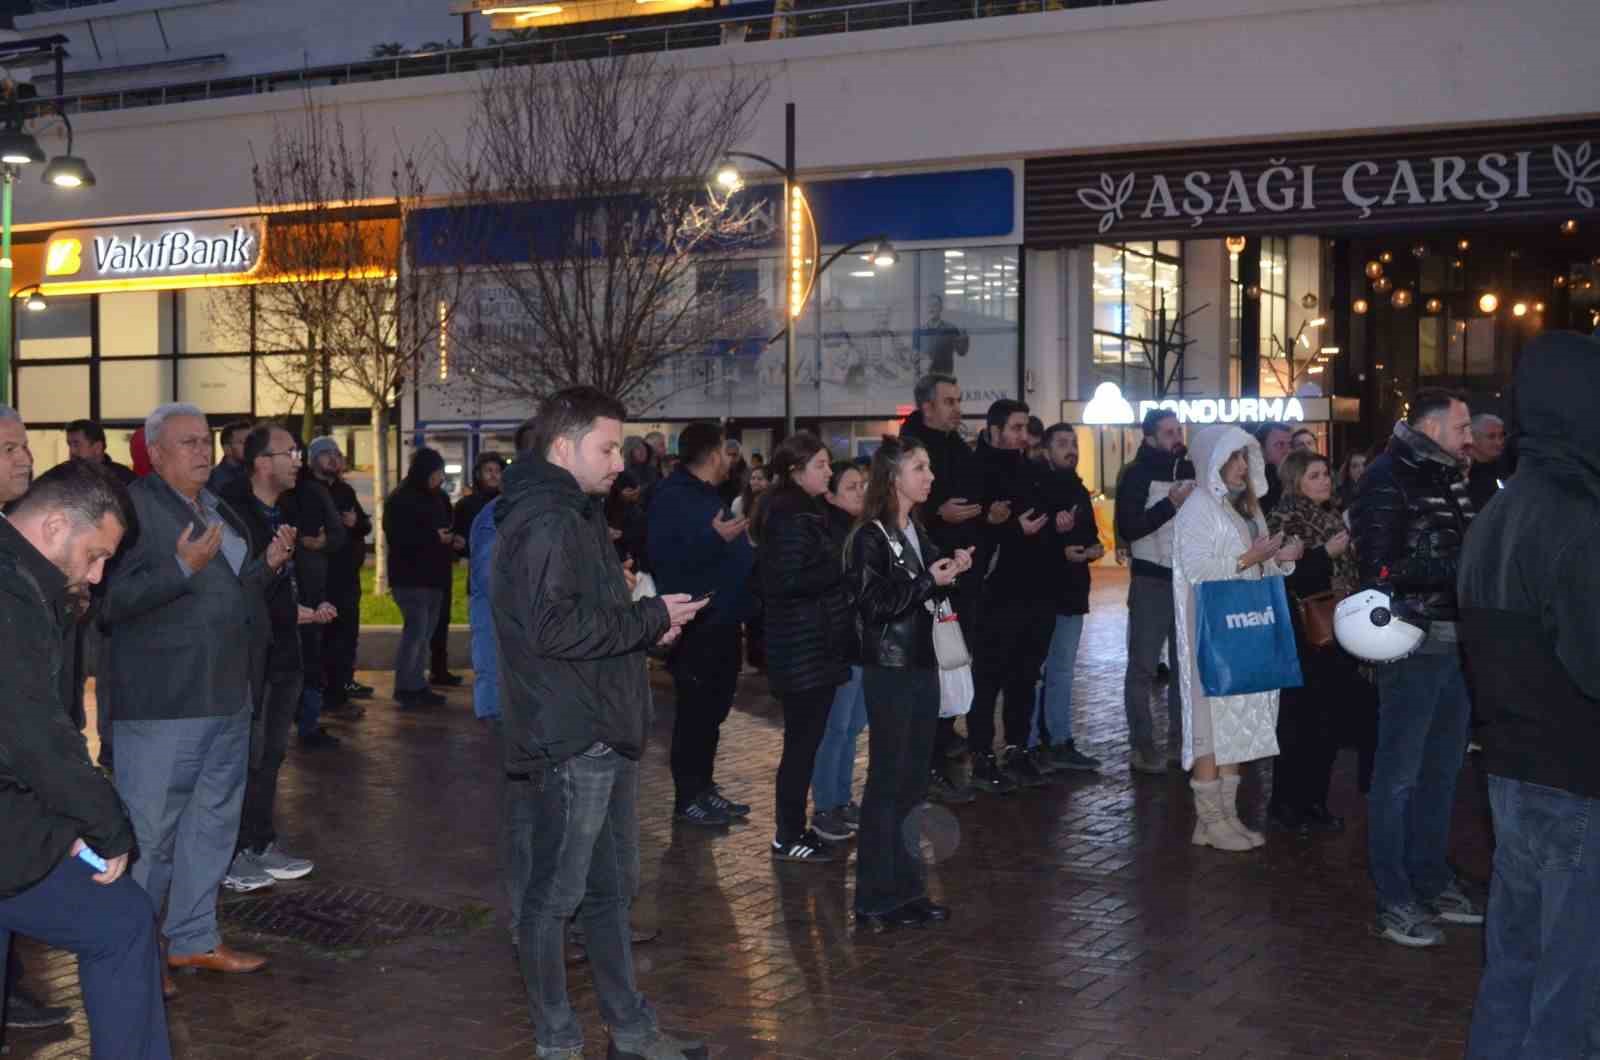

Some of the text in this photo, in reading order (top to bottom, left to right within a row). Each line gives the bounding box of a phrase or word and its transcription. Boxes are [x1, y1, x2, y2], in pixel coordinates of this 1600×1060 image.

[1140, 151, 1532, 228] AŞAĞI ÇARŞI
[93, 228, 253, 274] VakıfBank
[1225, 606, 1275, 629] mavi
